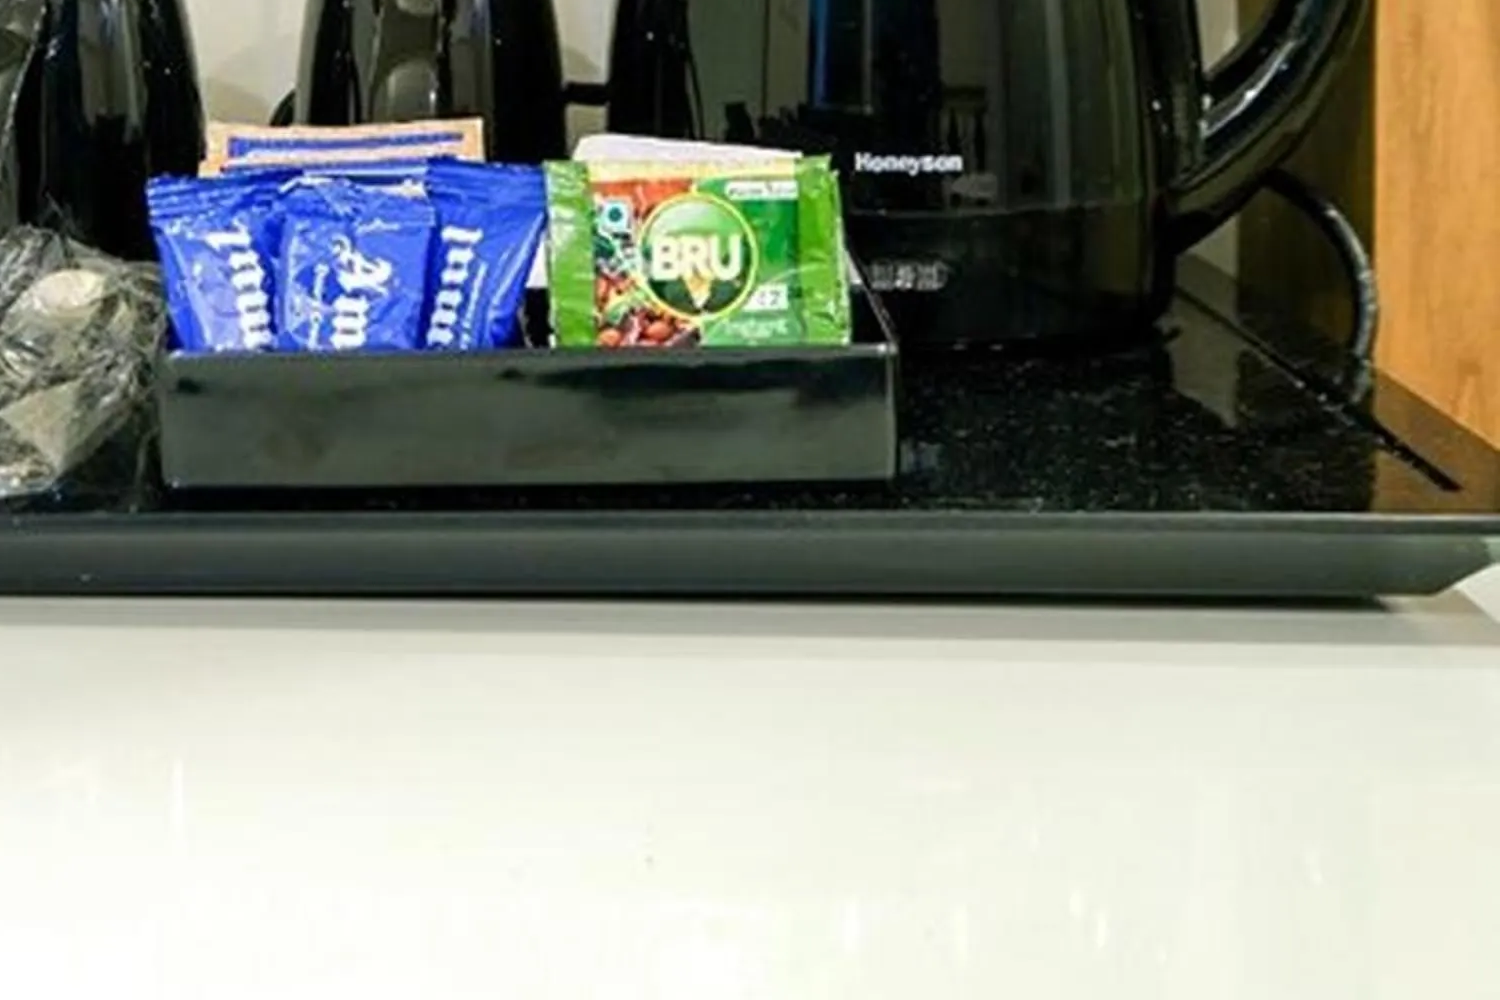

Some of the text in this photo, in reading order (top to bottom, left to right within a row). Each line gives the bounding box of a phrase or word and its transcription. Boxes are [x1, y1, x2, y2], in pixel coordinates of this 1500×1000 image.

[205, 219, 272, 350] mul
[328, 232, 392, 350] Am
[426, 225, 483, 348] mul
[652, 233, 743, 282] BRU
